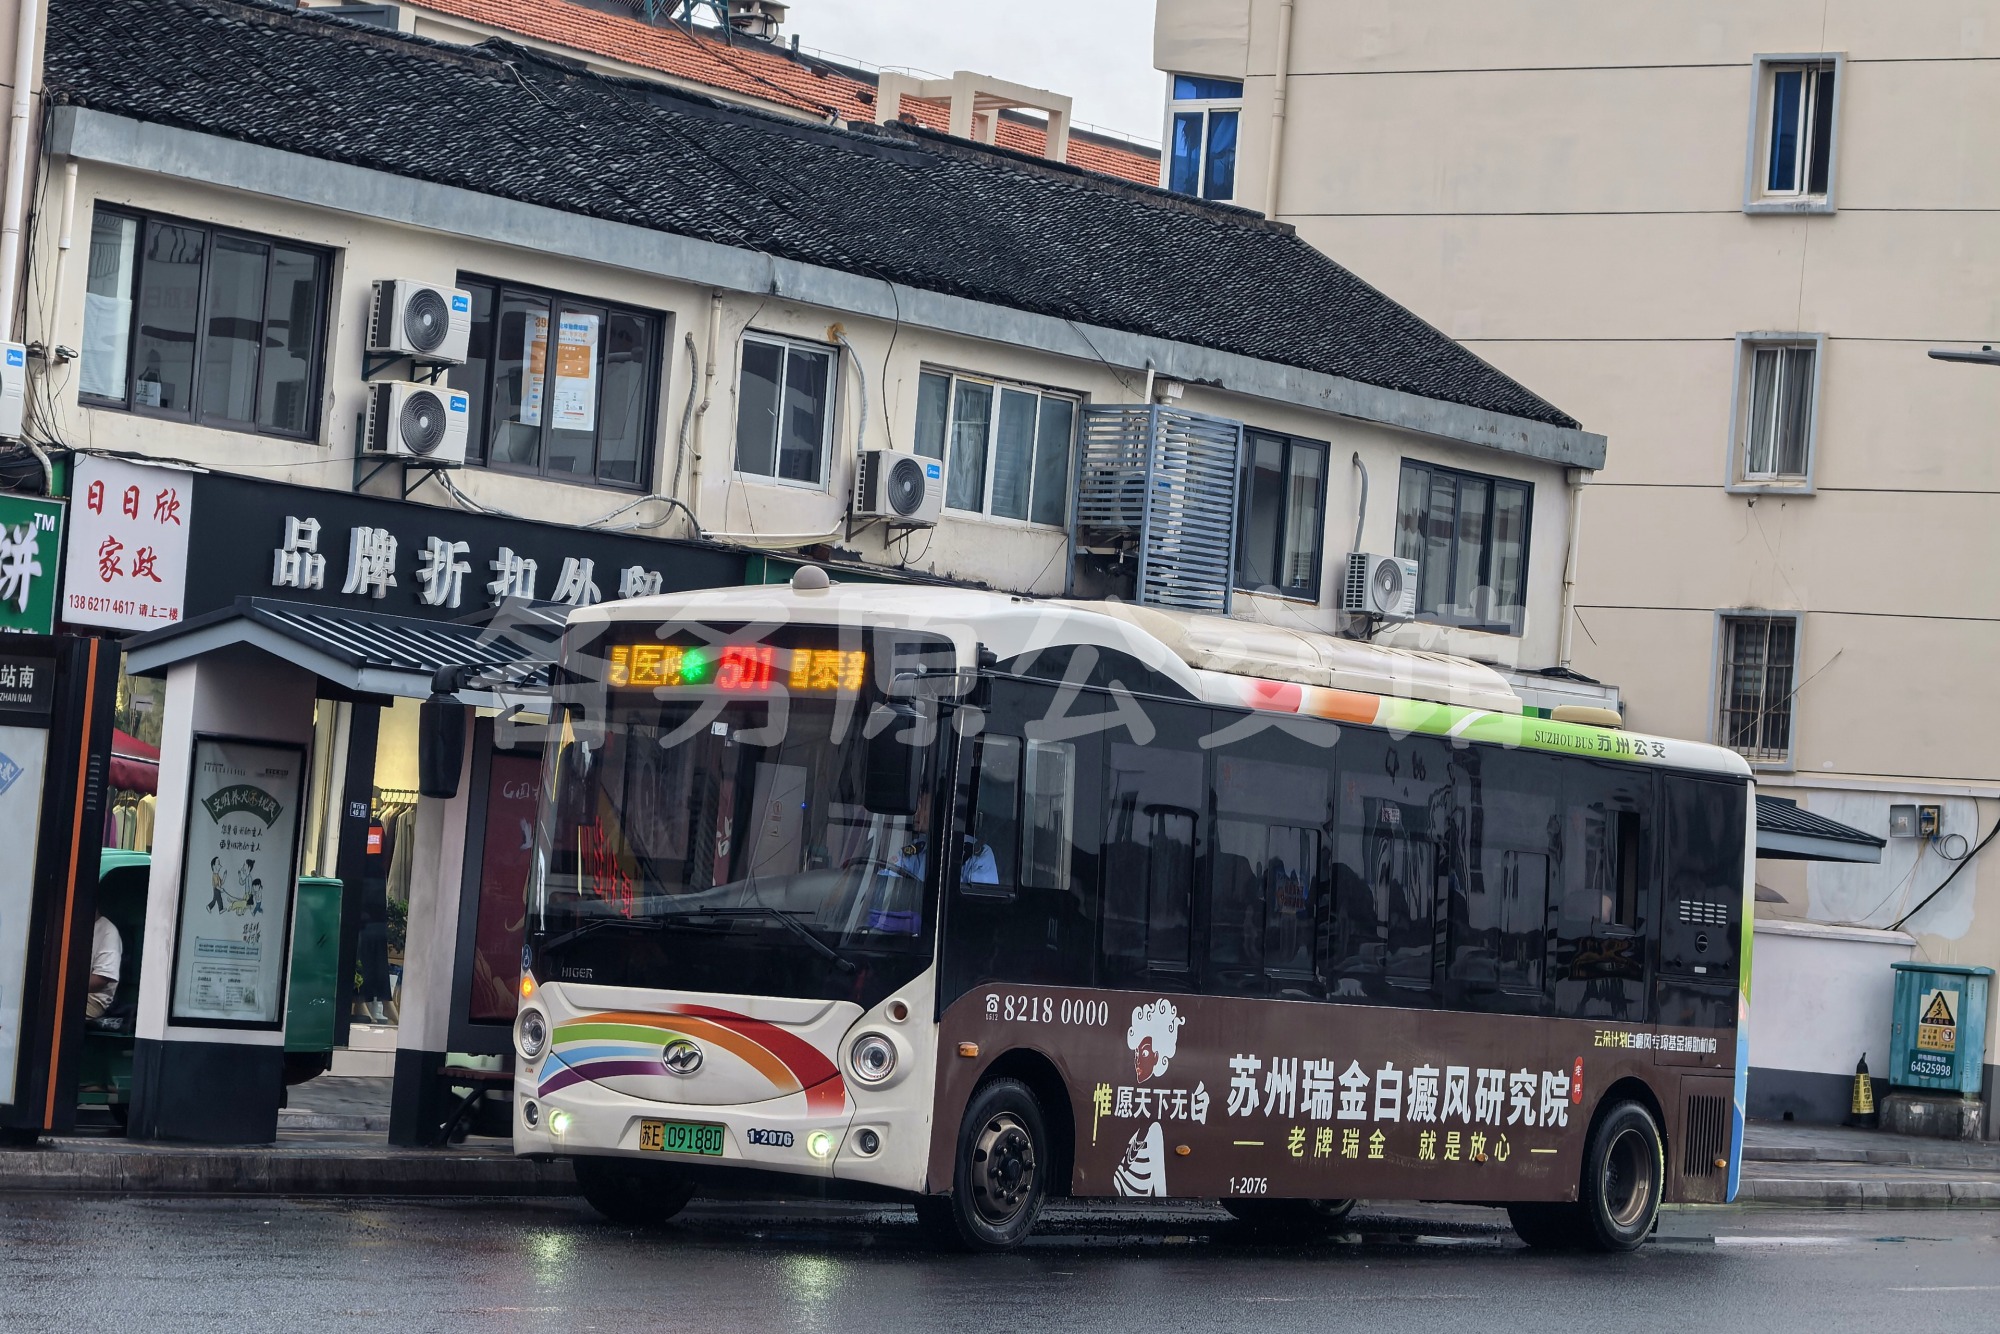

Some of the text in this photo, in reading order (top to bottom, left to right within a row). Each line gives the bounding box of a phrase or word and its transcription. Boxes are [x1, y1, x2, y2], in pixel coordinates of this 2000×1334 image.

[87, 480, 181, 526] 日日欣
[34, 512, 55, 532] TM
[98, 534, 162, 583] 家政
[69, 594, 178, 621] 138 6217 4617 请上二楼
[0, 664, 35, 689] 站南
[720, 646, 772, 690] 501
[1535, 730, 1666, 759] SUZHOU BUS 苏州公交
[561, 966, 593, 979] HIGER
[1004, 995, 1109, 1026] 8218 0000
[1911, 1061, 1951, 1076] 64525998
[1227, 1053, 1571, 1128] 苏州瑞金白癜风研究院
[1093, 1081, 1210, 1146] 惟愿天下无白
[1287, 1126, 1511, 1162] 老牌瑞金 就是放心
[1229, 1177, 1268, 1195] 1-2076
